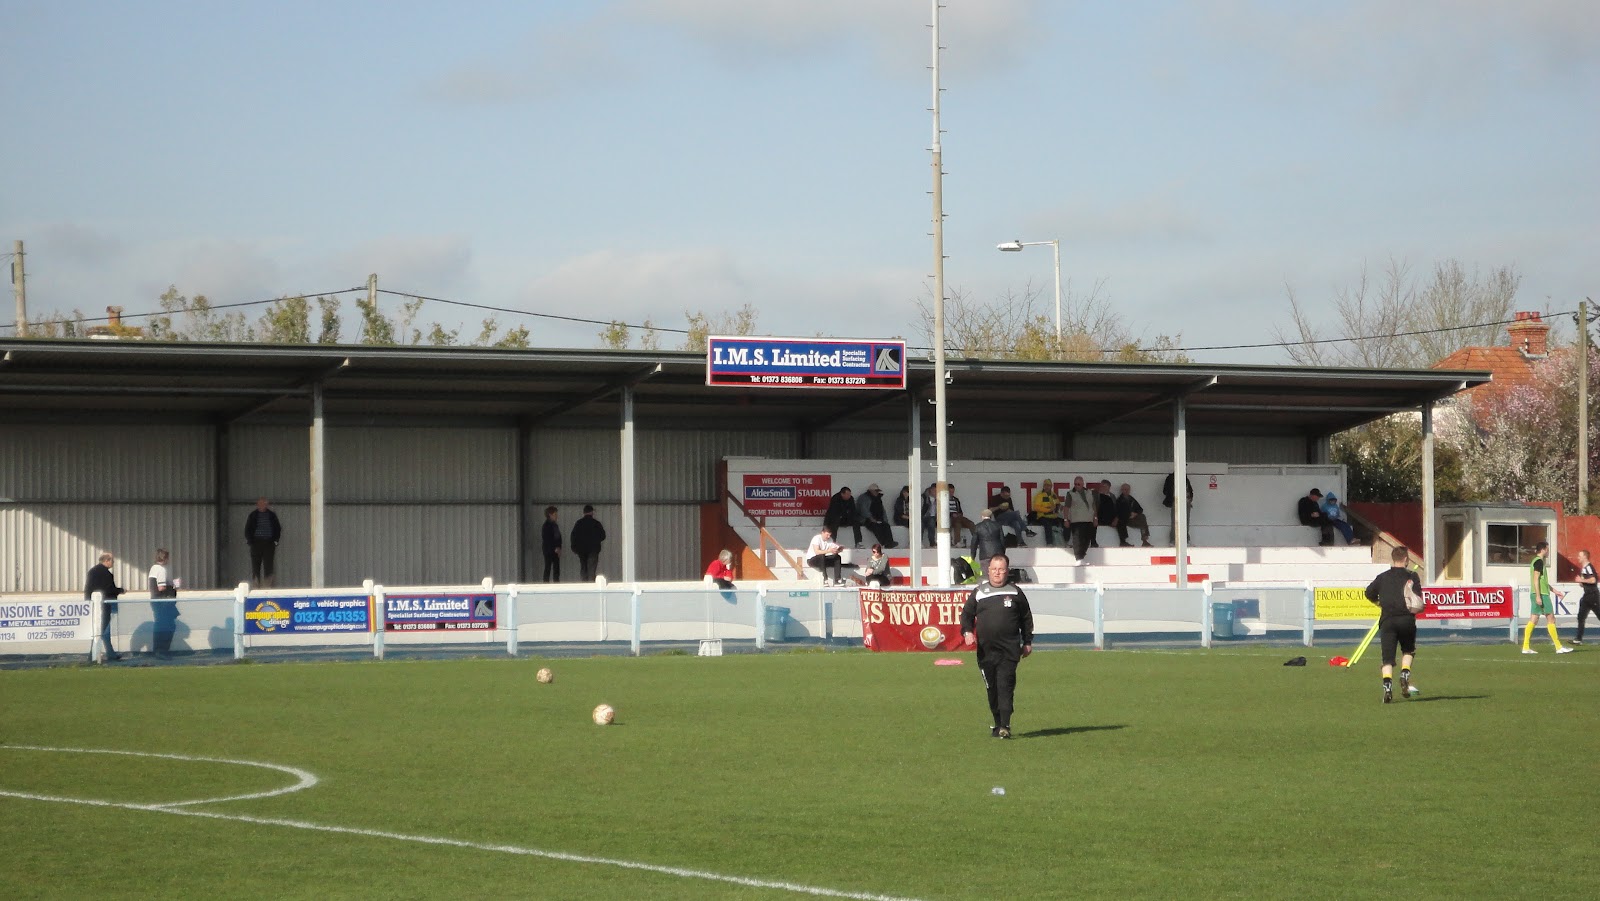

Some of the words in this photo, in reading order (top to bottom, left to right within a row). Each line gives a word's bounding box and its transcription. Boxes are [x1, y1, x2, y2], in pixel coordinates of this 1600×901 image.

[713, 347, 769, 366] I.M.S.
[771, 348, 842, 368] Limited
[751, 375, 761, 383] Tel:
[813, 376, 826, 384] Fax:
[751, 488, 790, 497] AlderSmith
[797, 489, 830, 497] STADIUM
[861, 591, 880, 601] THE
[881, 592, 917, 603] PERFECT
[919, 592, 951, 603] COFFEE
[953, 592, 964, 602] AT
[1316, 589, 1344, 601] FROME
[1346, 589, 1366, 601] SCA
[1422, 591, 1465, 605] FROME
[1469, 590, 1505, 604] TIMES
[293, 600, 310, 609] signs
[317, 600, 338, 608] vehicle
[339, 599, 366, 608] graphics
[387, 599, 423, 611] I.M.S.
[424, 599, 469, 610] Limited
[0, 605, 43, 619] NSOME
[47, 604, 55, 617] &
[60, 604, 90, 617] SONS
[294, 611, 325, 622] 01373
[327, 610, 366, 622] 451353
[864, 602, 885, 624] IS
[888, 603, 932, 625] NOW
[33, 618, 79, 626] MERCHANTS
[269, 618, 290, 628] design
[27, 631, 48, 640] 01225
